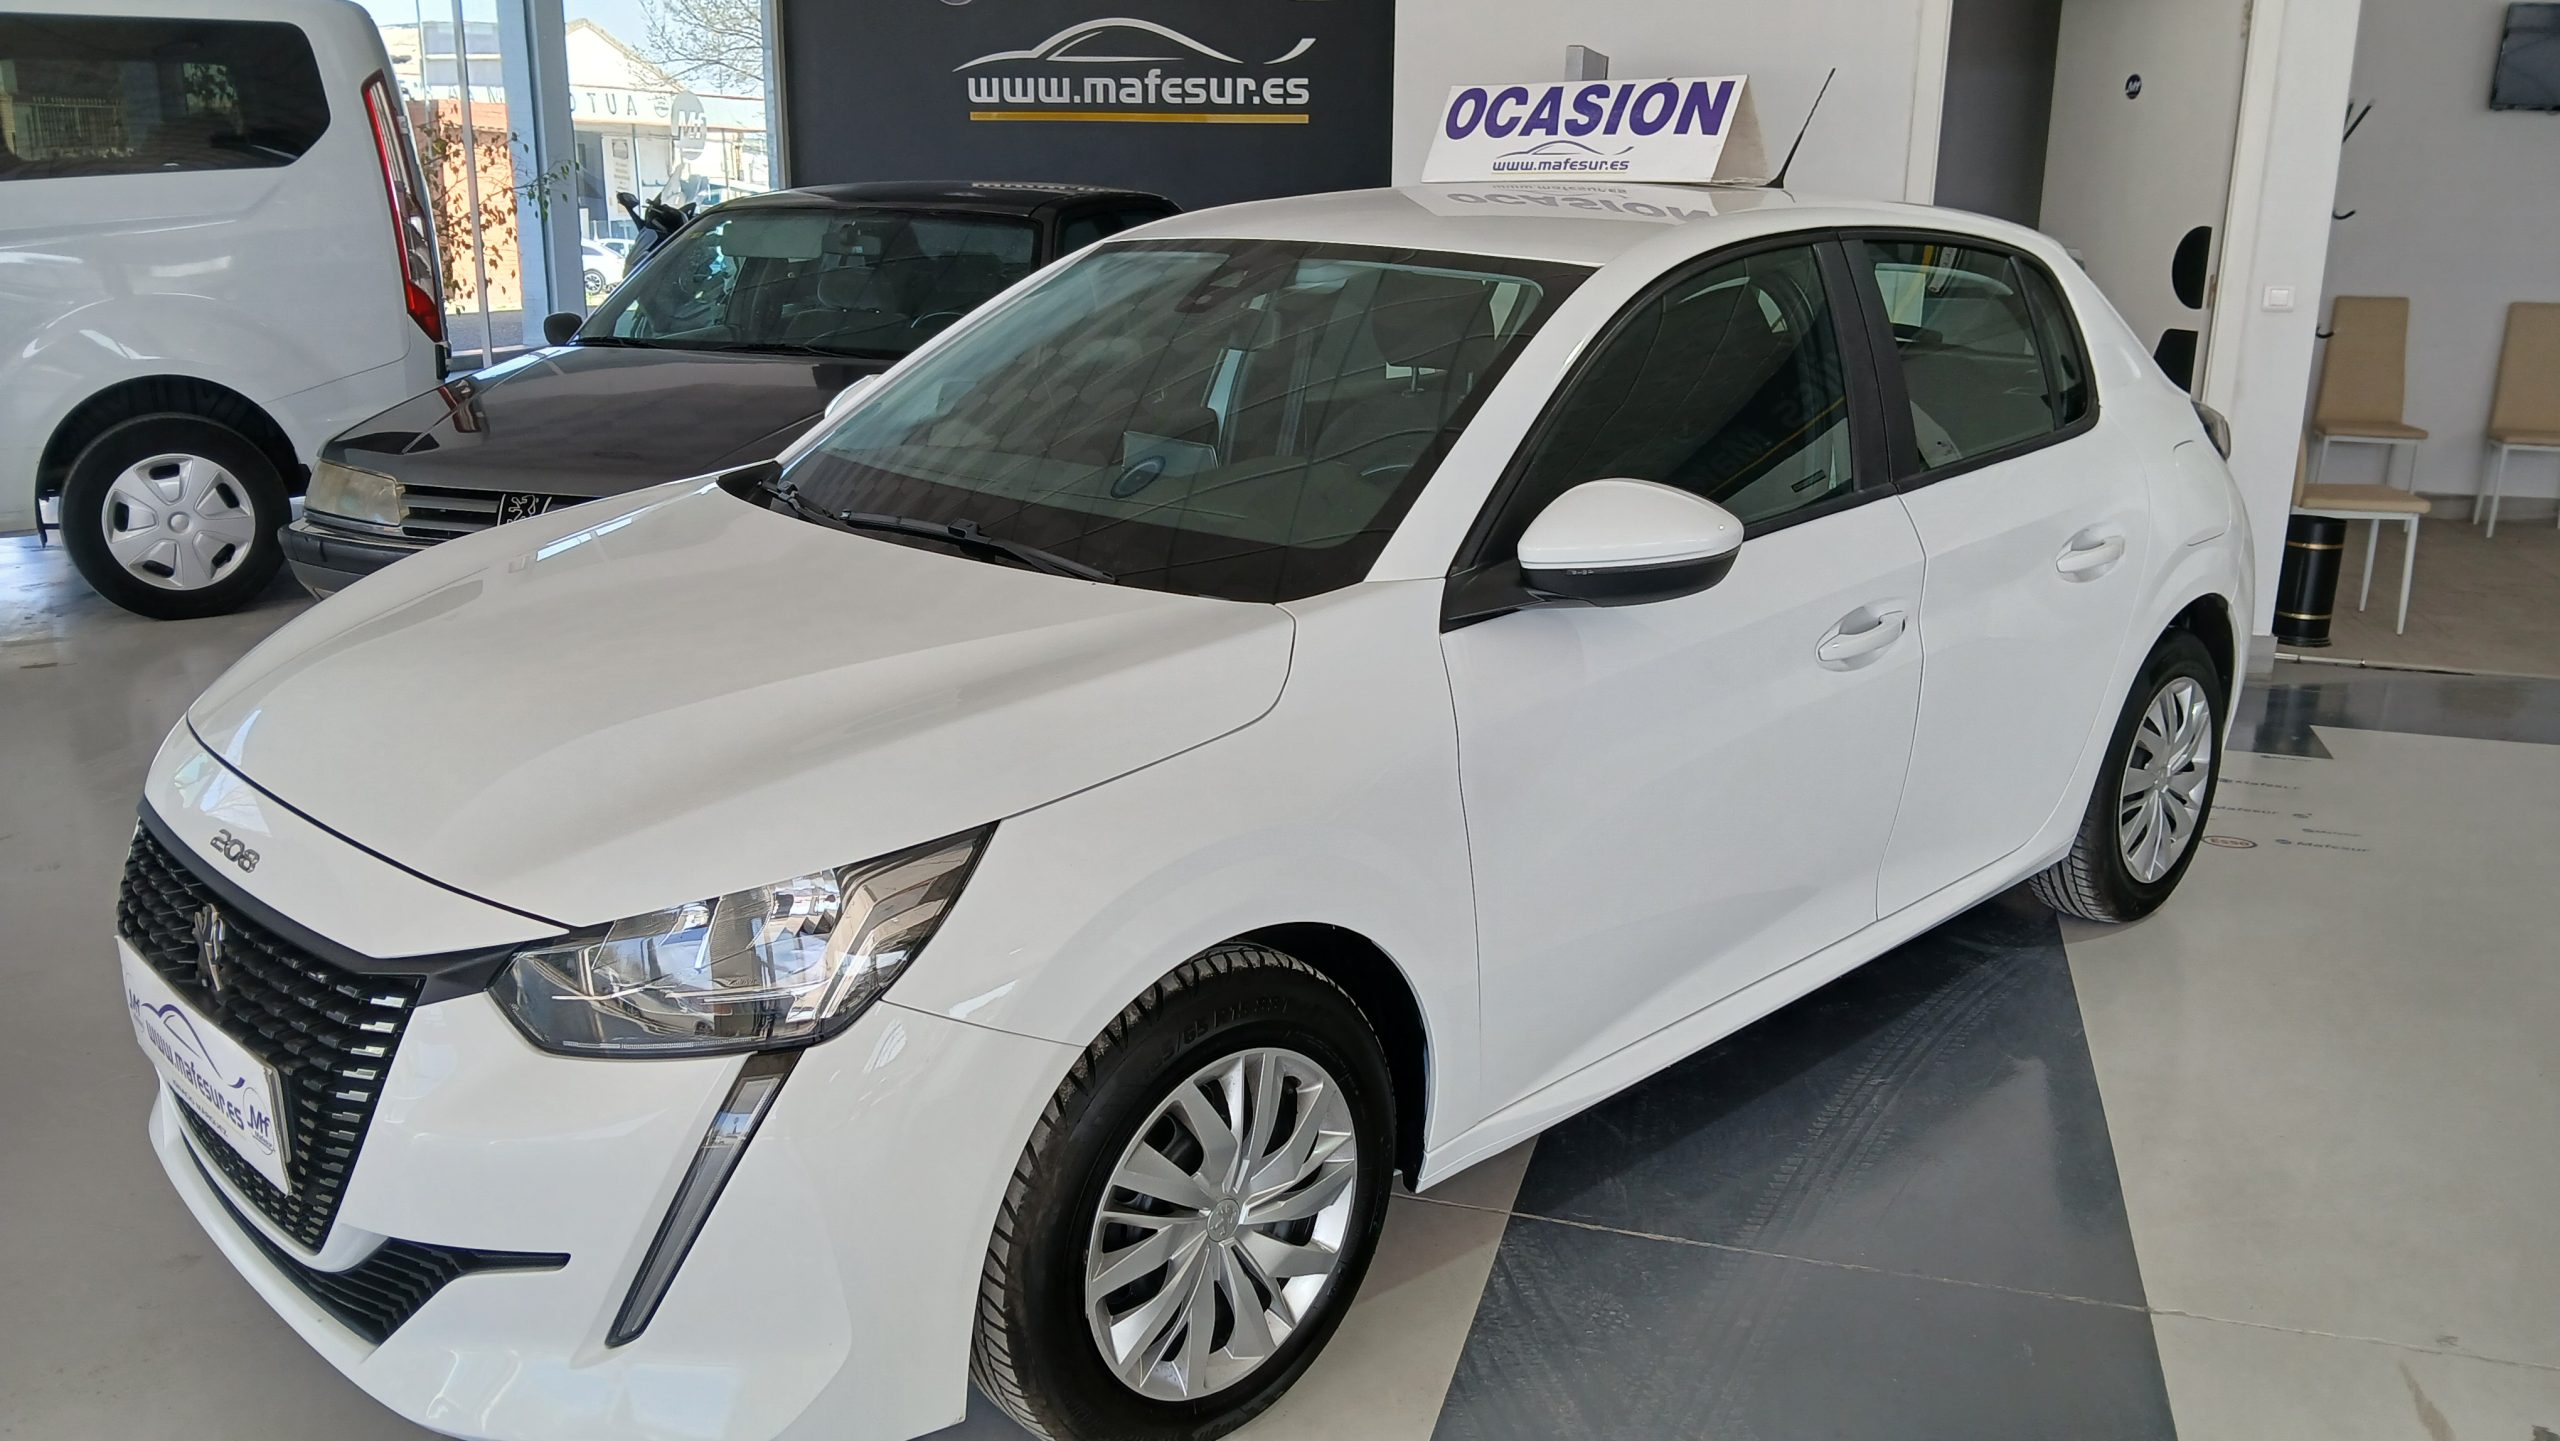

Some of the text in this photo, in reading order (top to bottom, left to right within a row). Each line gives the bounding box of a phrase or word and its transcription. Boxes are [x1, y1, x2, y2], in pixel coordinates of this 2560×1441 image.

[967, 69, 1310, 105] www.mafesur.es
[1446, 77, 1736, 140] OCASIÓN
[1492, 158, 1630, 172] www.mafesur.es
[210, 829, 260, 873] 208
[145, 1020, 244, 1130] www.mafesur.es
